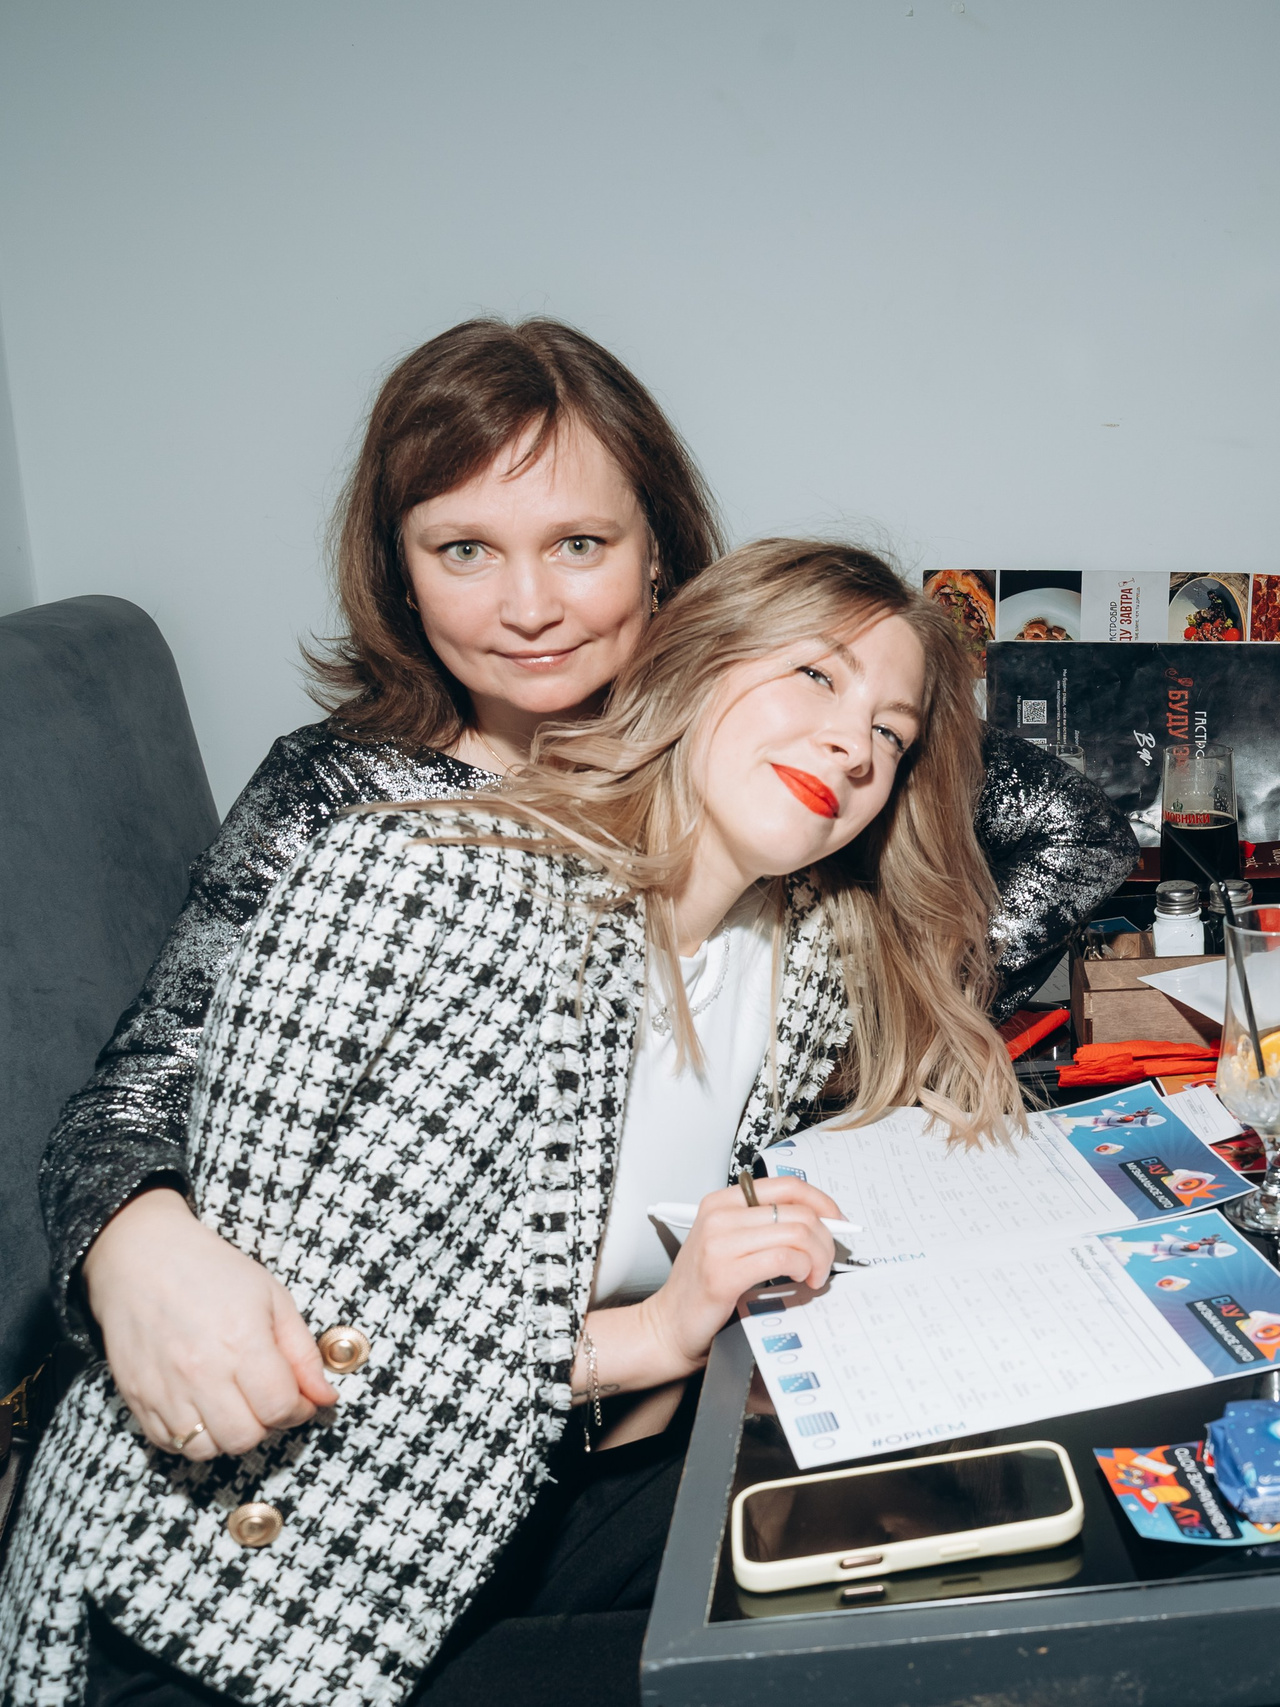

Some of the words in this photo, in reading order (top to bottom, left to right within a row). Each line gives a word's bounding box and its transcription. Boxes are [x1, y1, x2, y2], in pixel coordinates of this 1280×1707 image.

[1120, 587, 1133, 625] ЗАВТРА
[1109, 601, 1117, 641] АСТРОБАР
[1119, 628, 1133, 641] ДУ
[1166, 690, 1190, 740] БУДУ
[1163, 811, 1211, 824] МОВНИКИ
[1141, 1158, 1169, 1175] ВАУ
[1211, 1296, 1245, 1318] ВАУ
